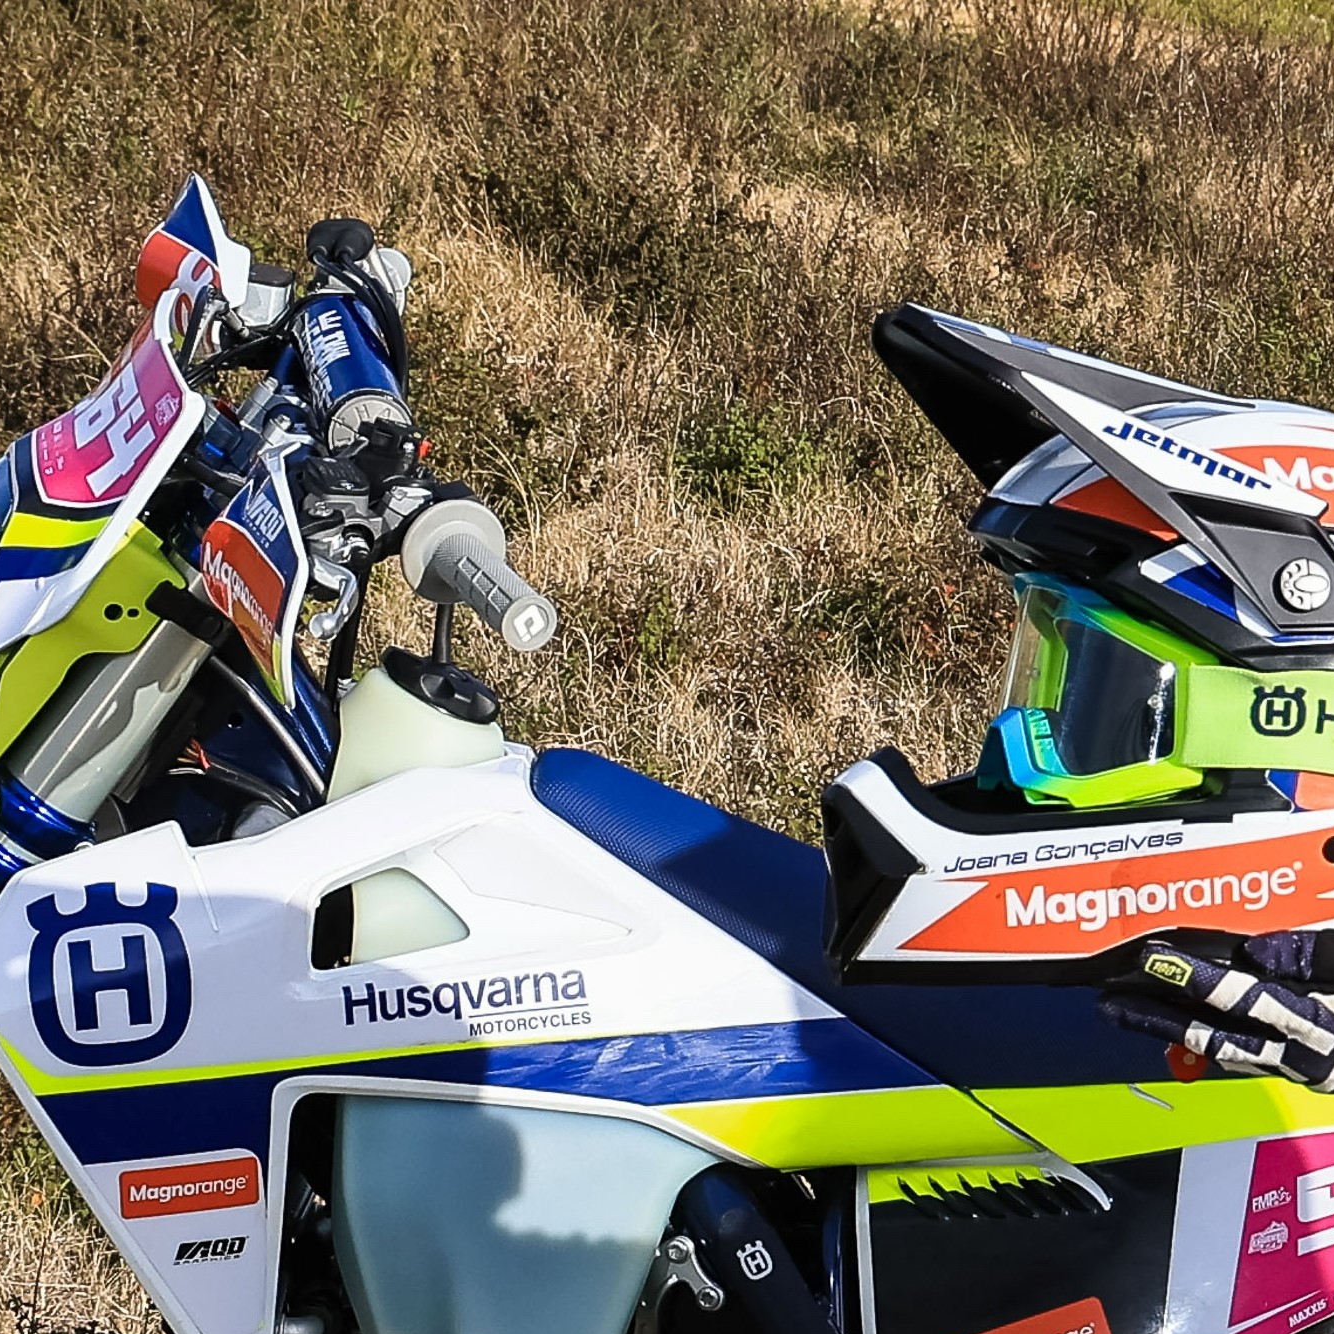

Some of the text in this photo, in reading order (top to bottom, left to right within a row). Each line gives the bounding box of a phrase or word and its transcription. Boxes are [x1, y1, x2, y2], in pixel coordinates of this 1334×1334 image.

[943, 829, 1184, 874] Joana Gonçalves
[1004, 863, 1301, 933] Magnorange
[341, 968, 588, 1026] Husqvarna
[468, 1011, 592, 1037] MOTORCYCLES
[129, 1176, 247, 1203] Magnorange
[1288, 1299, 1328, 1328] MAXXIS
